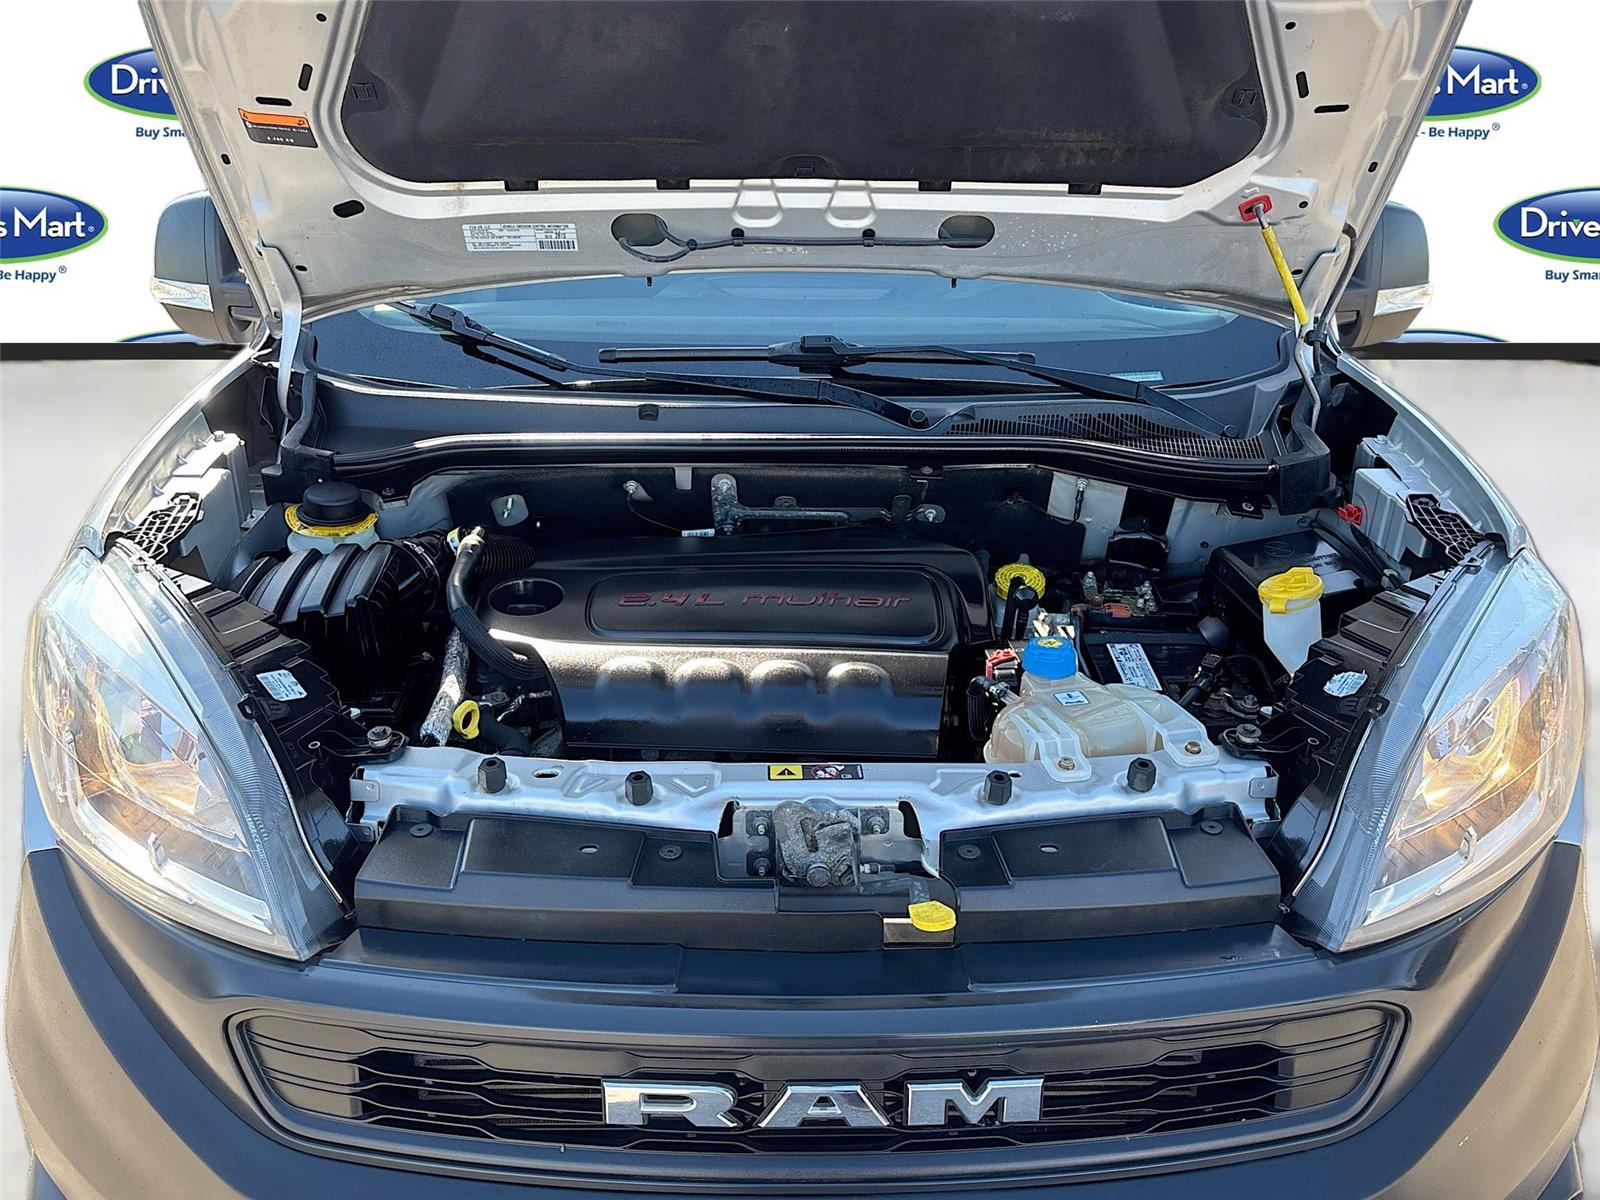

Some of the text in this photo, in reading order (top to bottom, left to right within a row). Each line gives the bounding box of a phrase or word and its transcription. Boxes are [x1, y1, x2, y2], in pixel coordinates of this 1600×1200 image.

[1447, 64, 1519, 95] Mart
[135, 126, 160, 140] Buy
[1428, 126, 1445, 138] Be
[1448, 126, 1490, 140] Happy
[14, 206, 86, 238] Mart
[1521, 206, 1600, 238] Drive
[15, 269, 57, 283] Happy
[1545, 269, 1570, 283] Buy
[602, 1077, 1047, 1129] RAM
